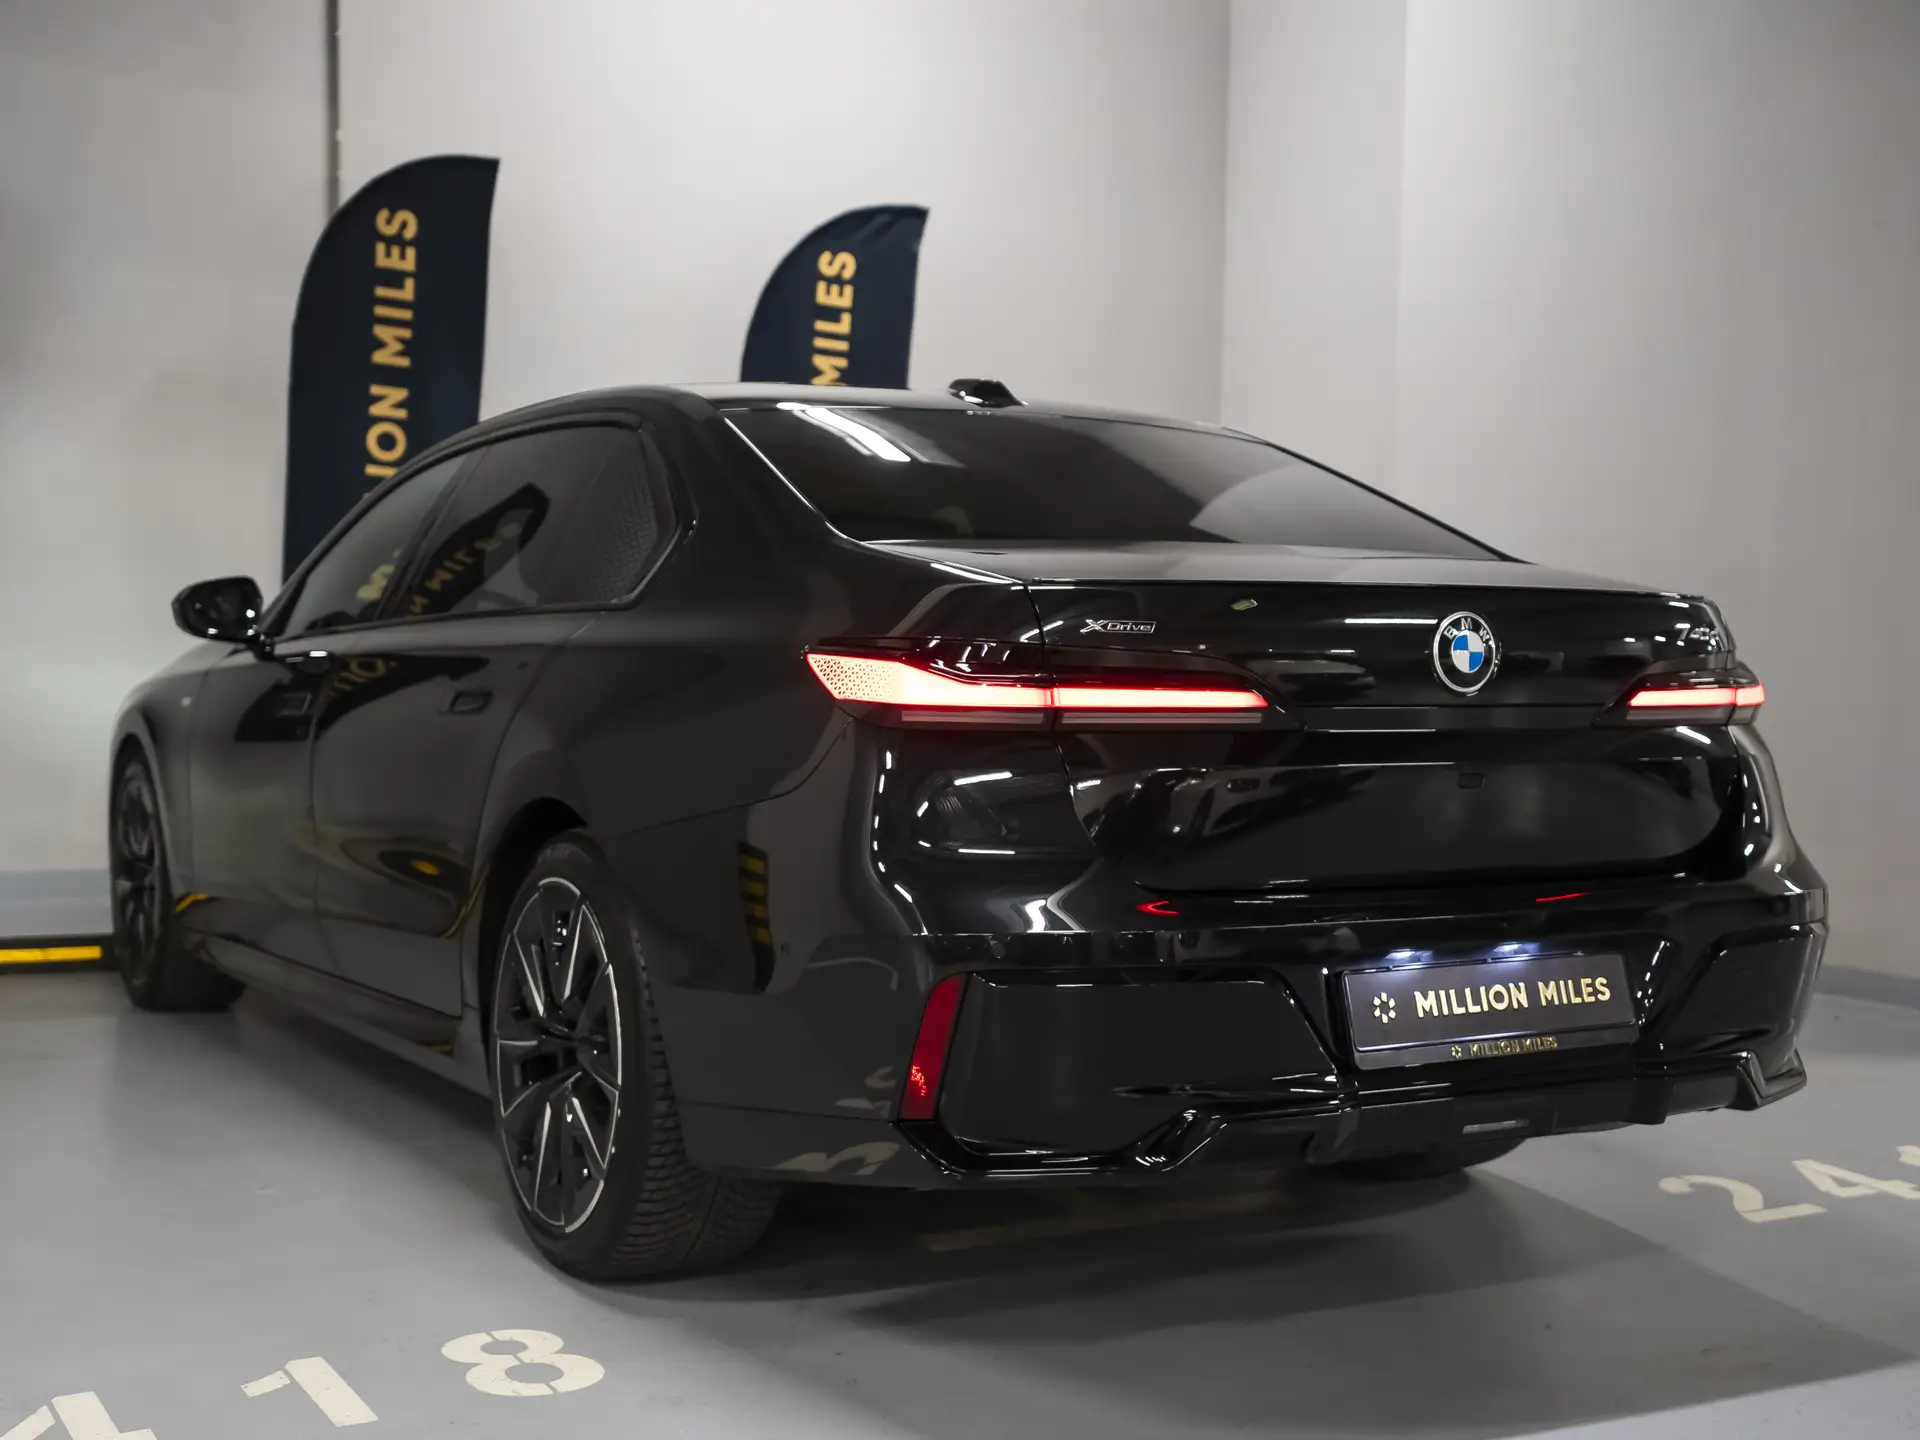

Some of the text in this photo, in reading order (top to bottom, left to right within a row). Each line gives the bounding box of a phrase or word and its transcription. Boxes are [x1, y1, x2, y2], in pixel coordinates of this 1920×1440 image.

[371, 208, 418, 367] MILES
[811, 250, 856, 386] MILES
[1443, 617, 1490, 641] BMW
[1414, 977, 1611, 1018] MILLION MILES
[1469, 1036, 1558, 1057] MILLION MILES
[1658, 1144, 1920, 1222] 24
